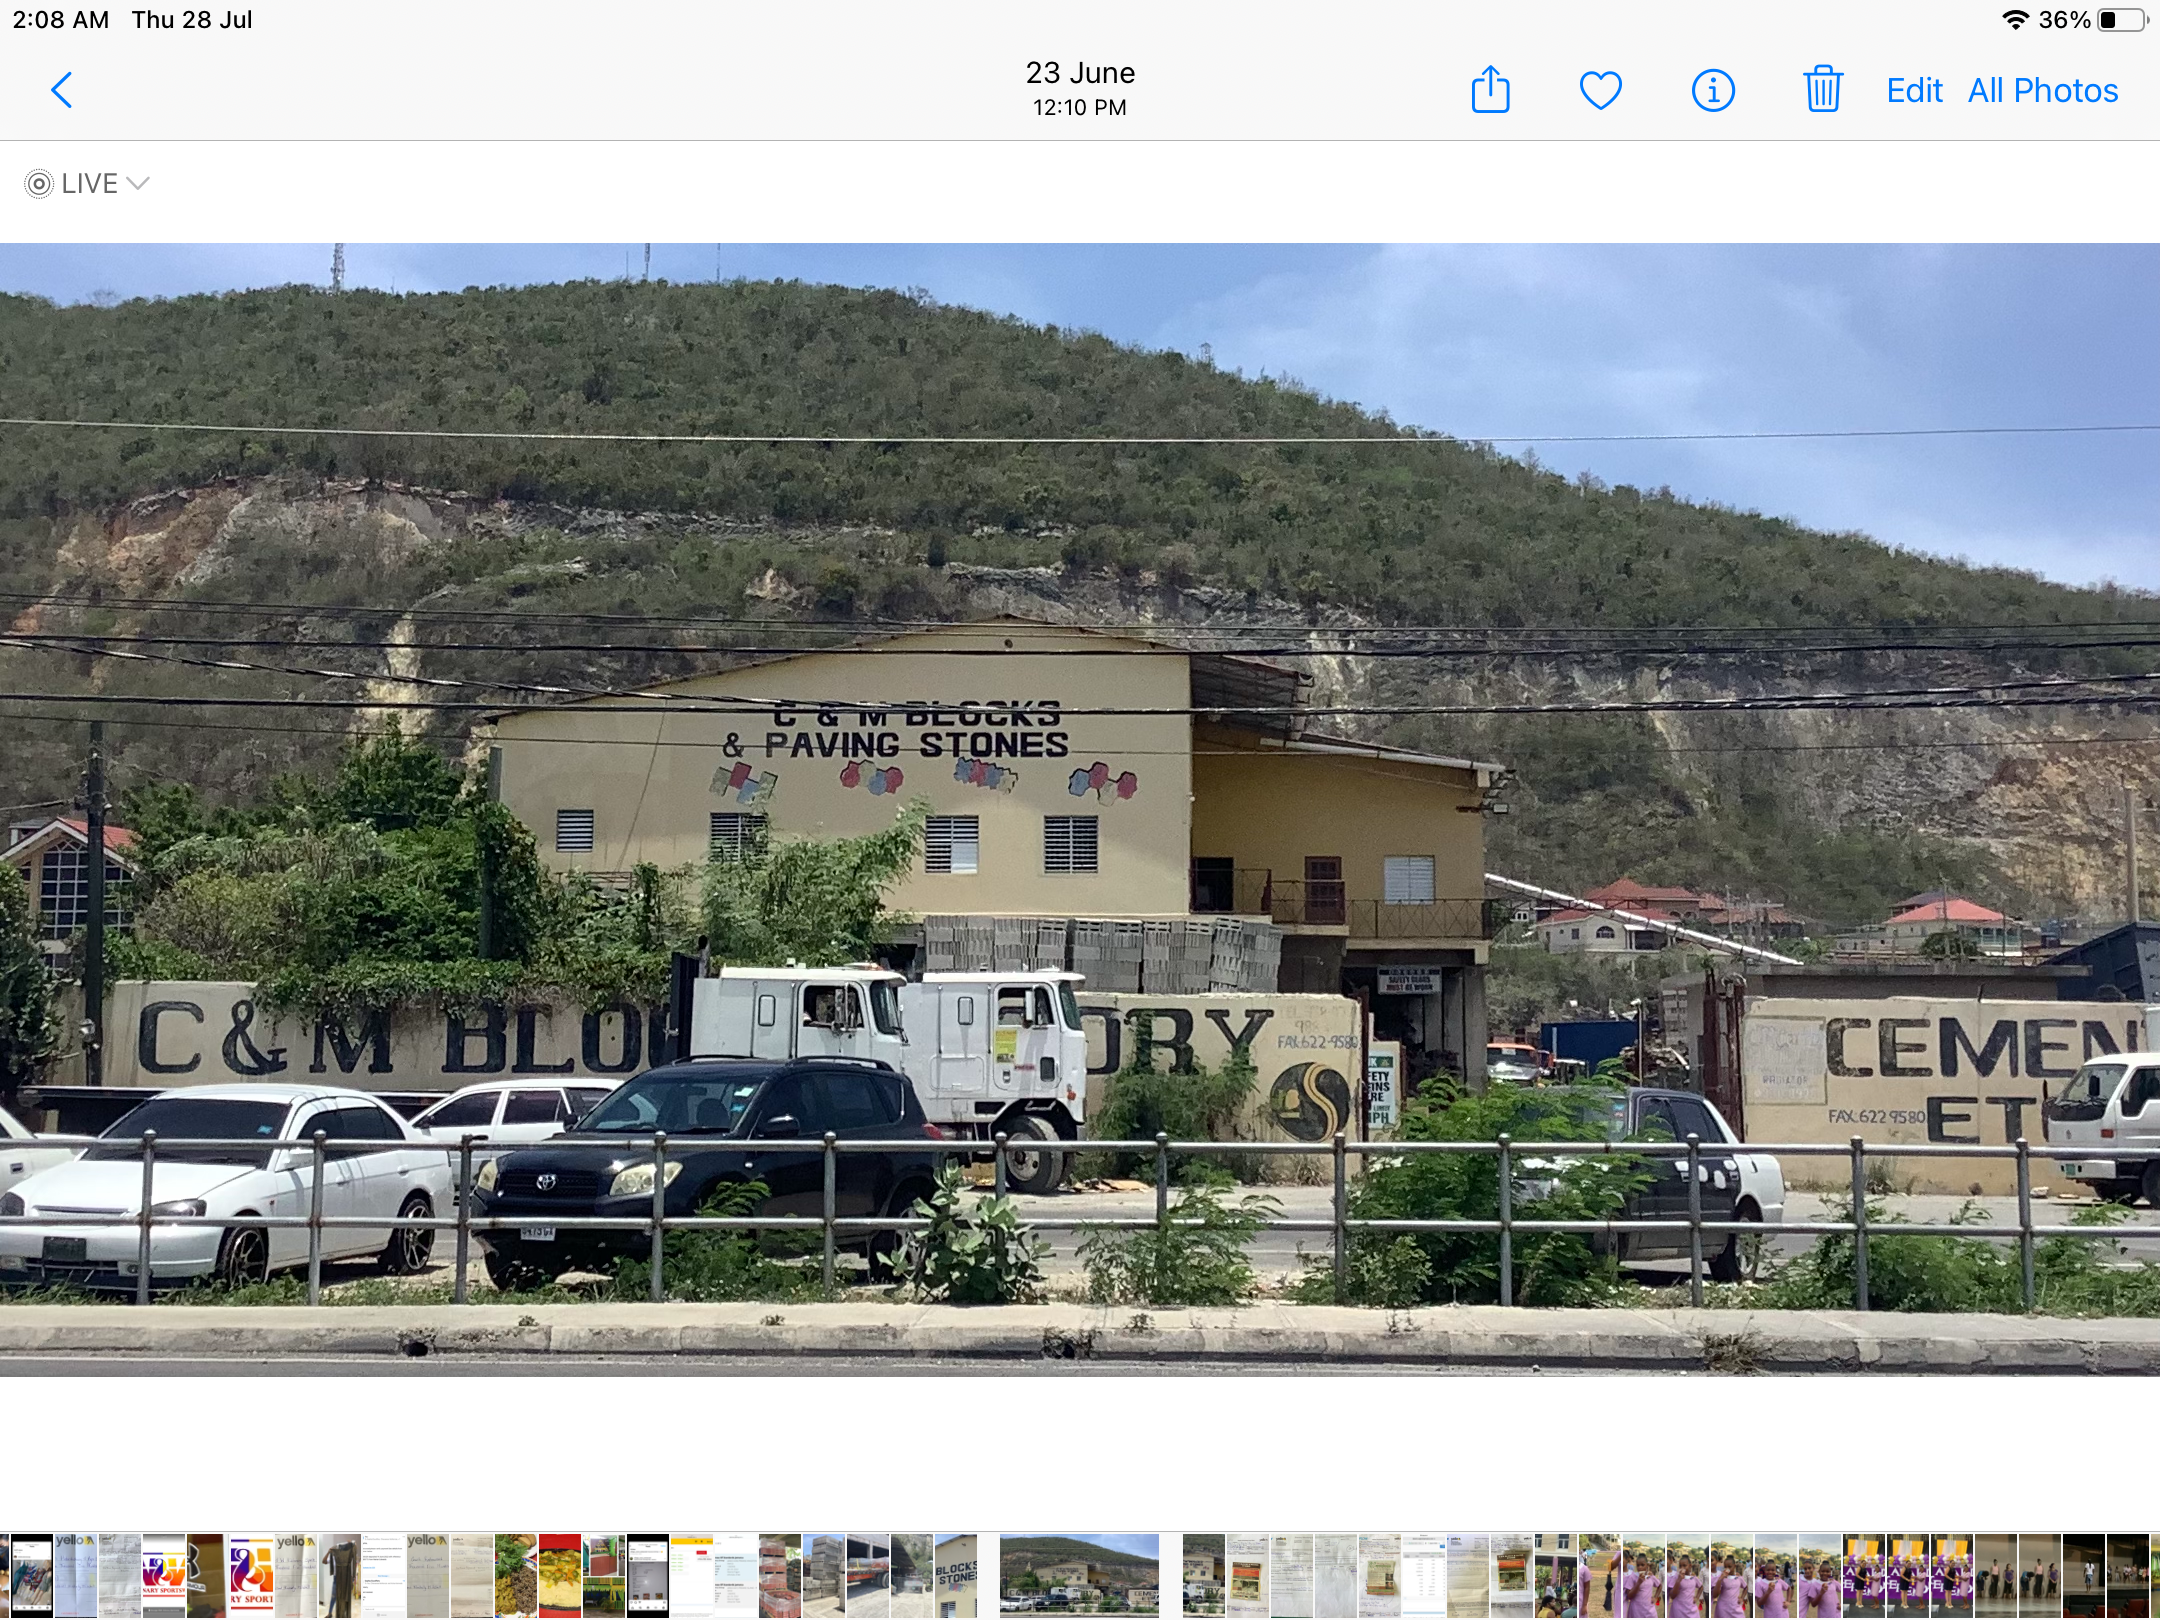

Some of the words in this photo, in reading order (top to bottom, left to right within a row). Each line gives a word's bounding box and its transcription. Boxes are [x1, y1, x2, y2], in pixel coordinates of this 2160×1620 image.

[773, 701, 796, 727] C
[817, 701, 838, 727] &
[860, 701, 886, 727] M
[905, 701, 1060, 727] BLOCKS
[722, 732, 744, 758] &
[766, 732, 899, 758] PAVING
[920, 732, 1069, 758] STONES
[139, 1000, 204, 1073] C
[222, 1000, 287, 1076] &
[309, 1001, 393, 1073] M
[1826, 1017, 2146, 1078] CEMEN
[1927, 1096, 2049, 1143] ET
[56, 1534, 84, 1547] yello
[277, 1535, 305, 1549] yello
[407, 1534, 436, 1548] yello
[939, 1571, 977, 1585] STONE
